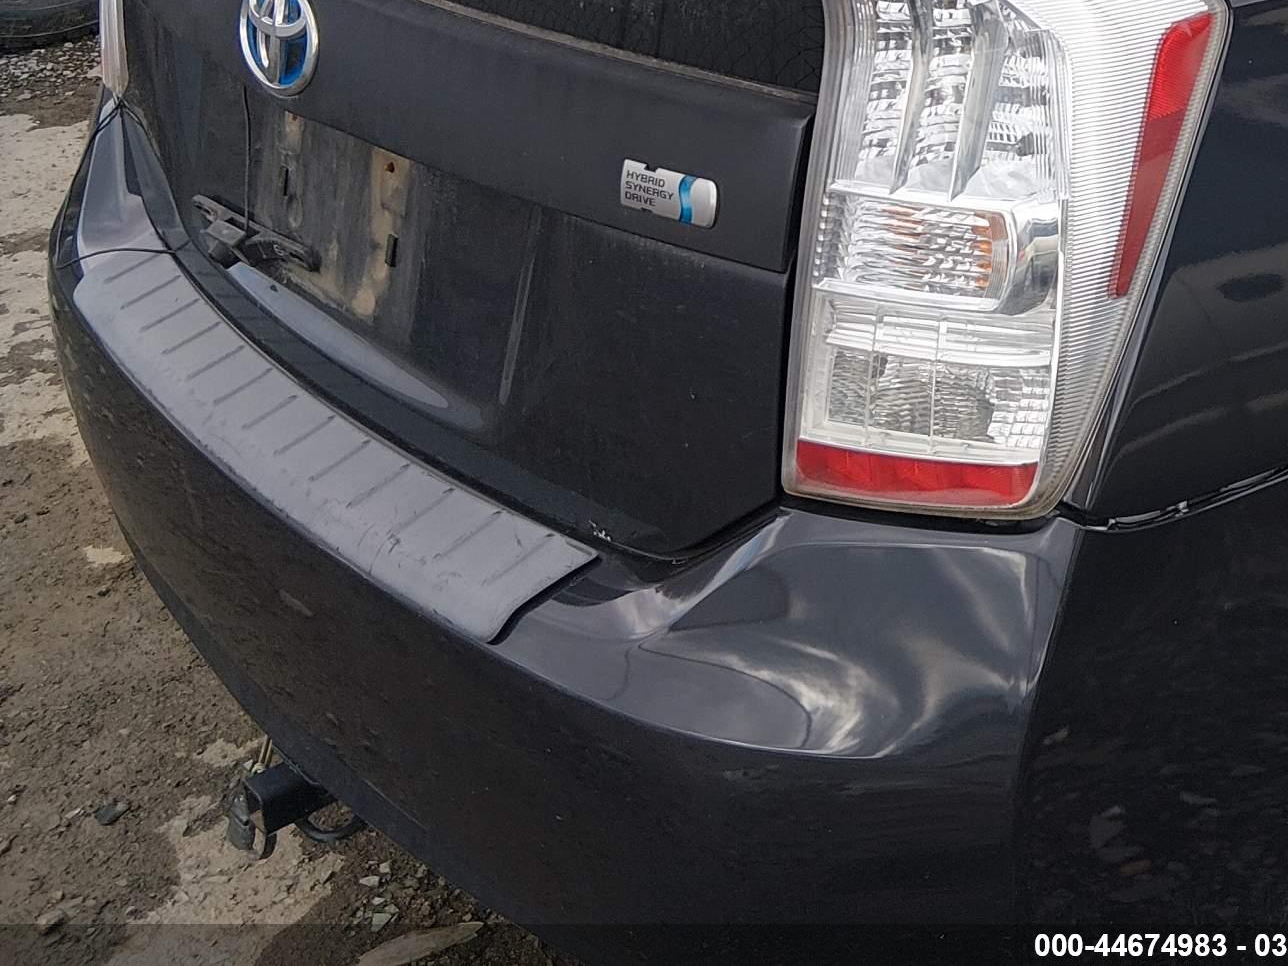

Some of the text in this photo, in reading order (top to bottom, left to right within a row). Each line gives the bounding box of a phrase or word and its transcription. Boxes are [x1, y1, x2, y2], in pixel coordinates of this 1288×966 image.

[626, 170, 666, 188] HYBRID
[624, 191, 656, 207] DRIVE
[625, 180, 675, 201] SYNERGY
